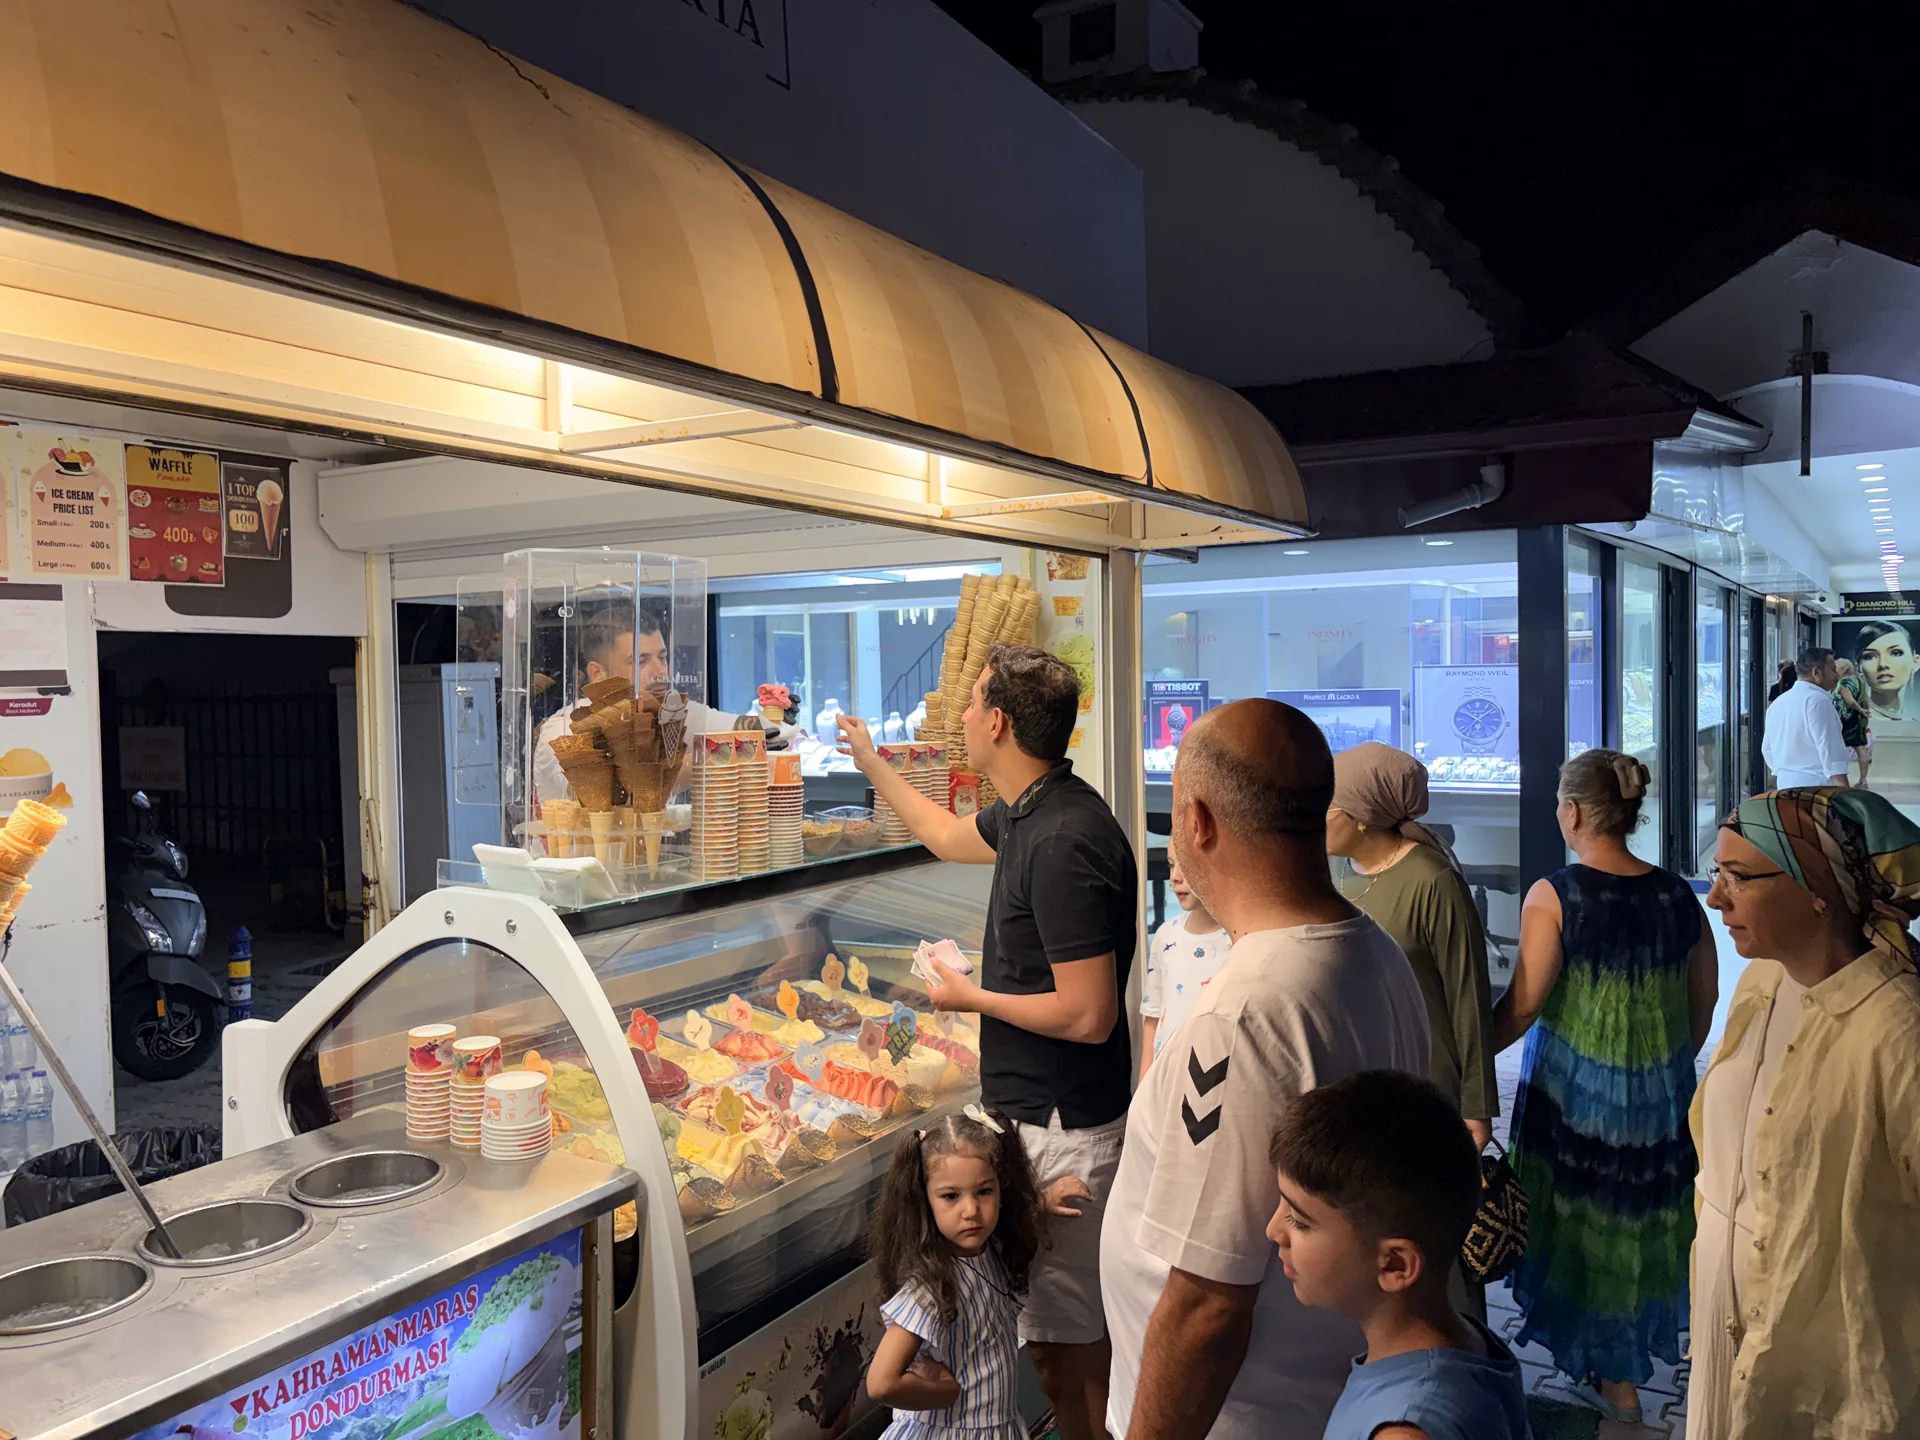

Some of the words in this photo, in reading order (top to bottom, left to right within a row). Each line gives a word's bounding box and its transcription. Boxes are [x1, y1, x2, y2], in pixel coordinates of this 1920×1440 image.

[148, 457, 193, 475] WAFFLE
[51, 488, 64, 499] ICE
[66, 490, 95, 501] CREAM
[235, 483, 255, 496] TOP
[53, 503, 76, 514] PRICE
[78, 505, 94, 515] LIST
[37, 519, 58, 527] Small
[90, 520, 104, 529] 200
[235, 513, 255, 525] 100
[37, 540, 66, 548] Medium
[90, 541, 105, 549] 400
[38, 560, 59, 569] Large
[90, 561, 105, 570] 600
[1166, 682, 1201, 691] TISSOT
[250, 1284, 479, 1419] KAHRAMANMARAŞ
[288, 1336, 450, 1440] DONDURMASI
